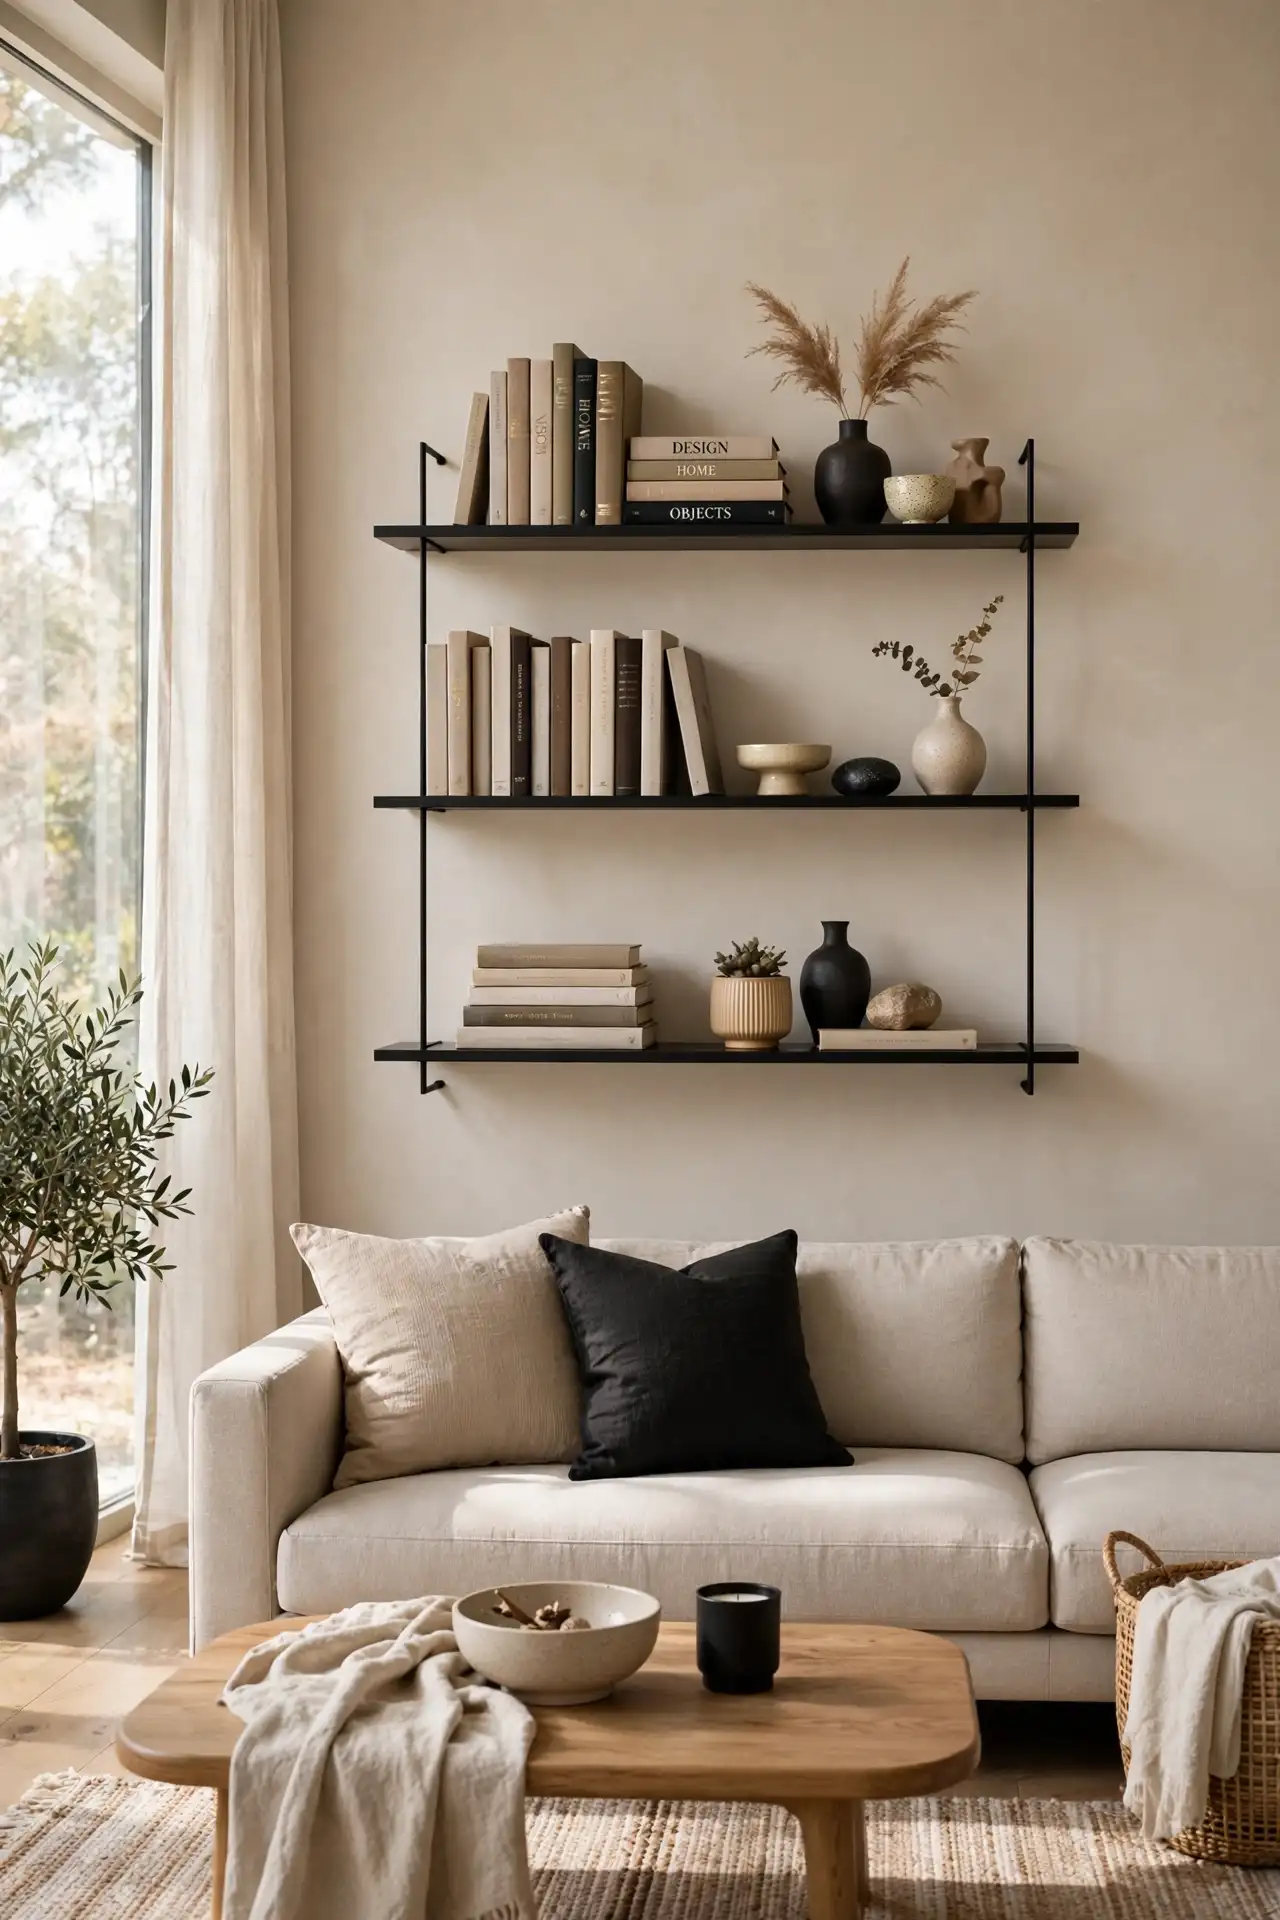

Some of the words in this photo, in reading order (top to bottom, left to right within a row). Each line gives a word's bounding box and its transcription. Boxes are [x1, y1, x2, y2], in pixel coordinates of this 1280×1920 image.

[672, 441, 729, 454] DESIGN
[676, 464, 717, 476] HOME
[669, 506, 732, 521] OBJECTS
